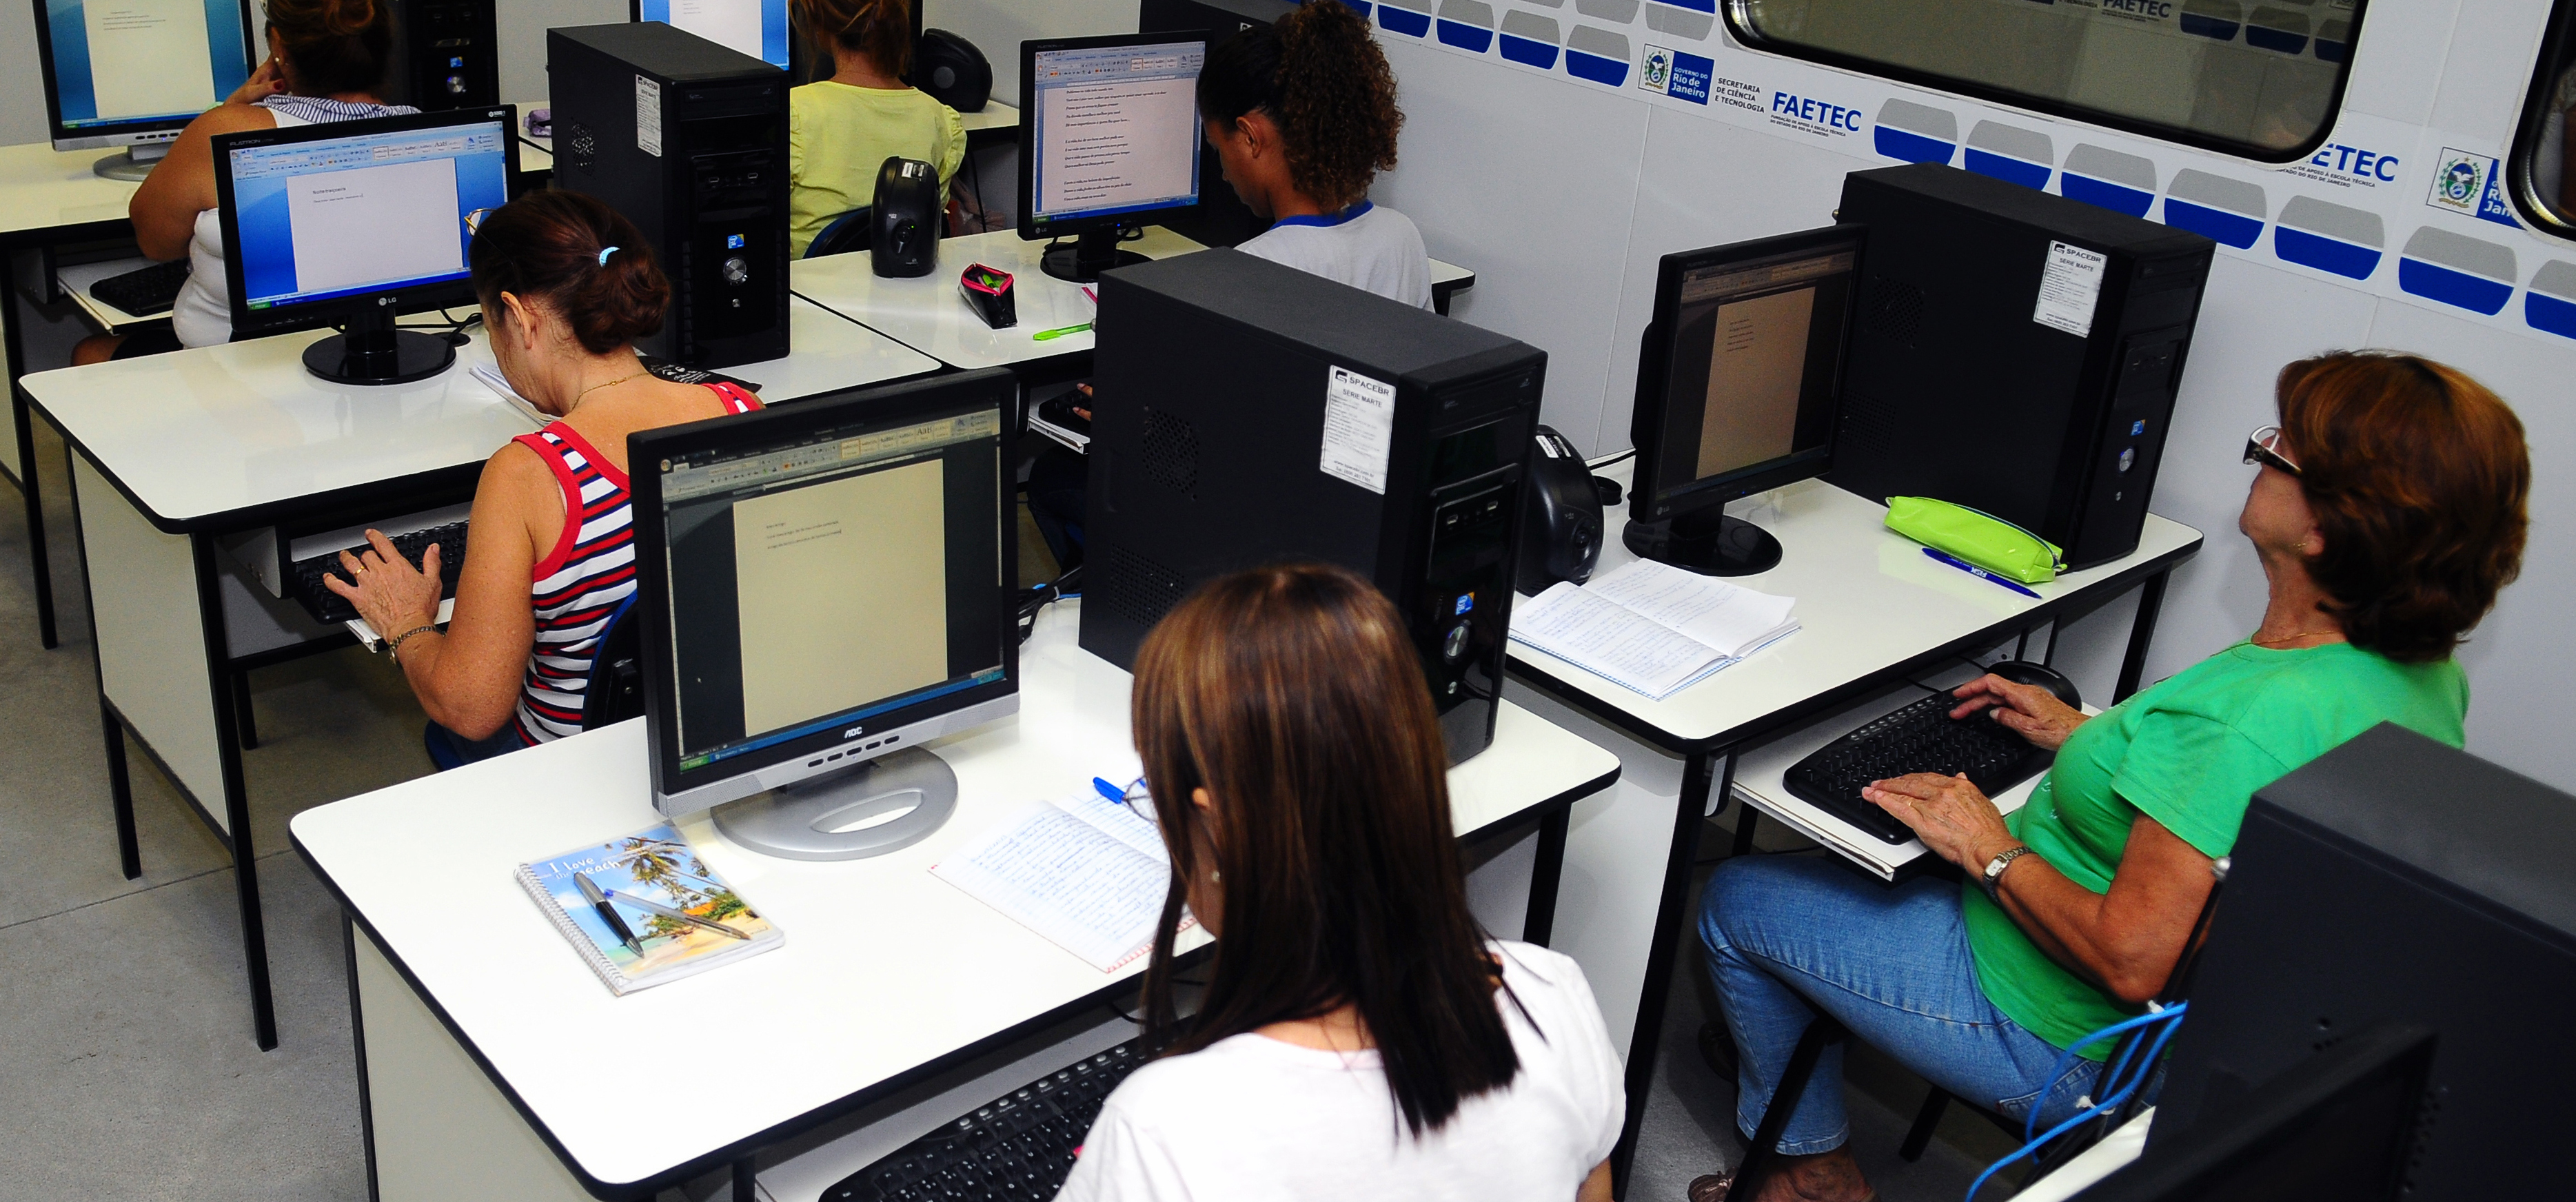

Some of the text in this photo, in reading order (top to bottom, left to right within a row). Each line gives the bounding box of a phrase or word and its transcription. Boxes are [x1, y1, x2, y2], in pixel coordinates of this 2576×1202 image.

[1672, 72, 1701, 88] Rio de
[1674, 67, 1699, 78] GOVERNO
[1671, 82, 1705, 99] Janeiro
[1718, 77, 1761, 94] SECRETARIA
[1716, 86, 1756, 102] DE CIÊNCIA
[1721, 96, 1765, 114] TECNOLOGIA
[1772, 91, 1862, 132] FAETEC
[2311, 143, 2400, 183] ETEC
[2306, 167, 2324, 176] APOIO
[2330, 173, 2351, 182] ESCOLA
[2352, 176, 2375, 187] TÉCNICA
[2326, 178, 2351, 188] JANEIRO
[2067, 247, 2102, 263] SPACEBR
[2075, 262, 2094, 272] MARTE
[1349, 376, 1390, 396] SPACEBR
[1361, 396, 1383, 408] MARTE
[844, 726, 863, 739] AOC
[549, 857, 596, 873] I love
